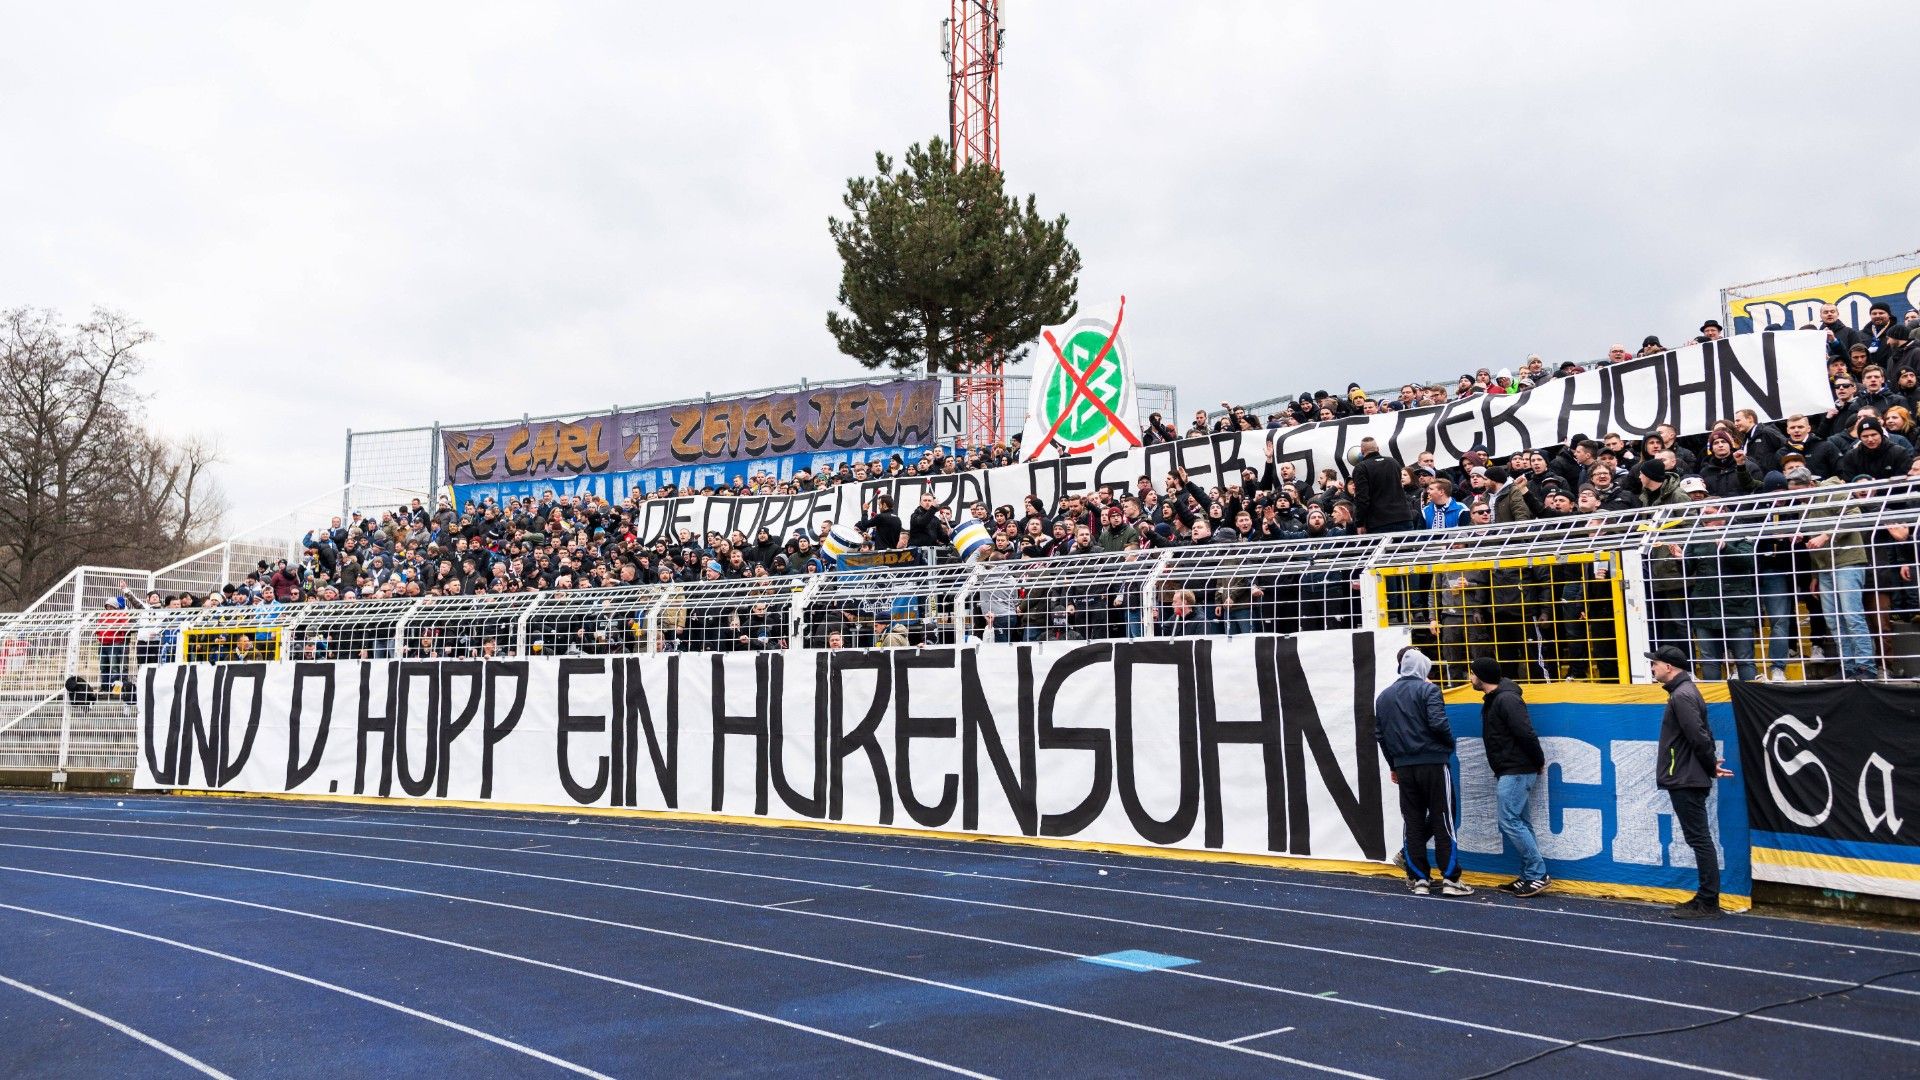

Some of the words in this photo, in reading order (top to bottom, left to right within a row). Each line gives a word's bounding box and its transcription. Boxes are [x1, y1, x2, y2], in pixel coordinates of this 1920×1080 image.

[504, 420, 610, 478] CARL
[669, 396, 798, 463] ZEISS
[805, 384, 934, 449] JENA
[644, 497, 695, 547] DIE
[1263, 415, 1371, 492] IST
[1388, 388, 1532, 468] DER
[1556, 331, 1784, 443] HOHN
[943, 404, 962, 435] N
[144, 661, 267, 788] UND
[354, 659, 529, 799] HOPP
[556, 655, 679, 809] EIN
[710, 631, 1387, 862] HURENSOHN
